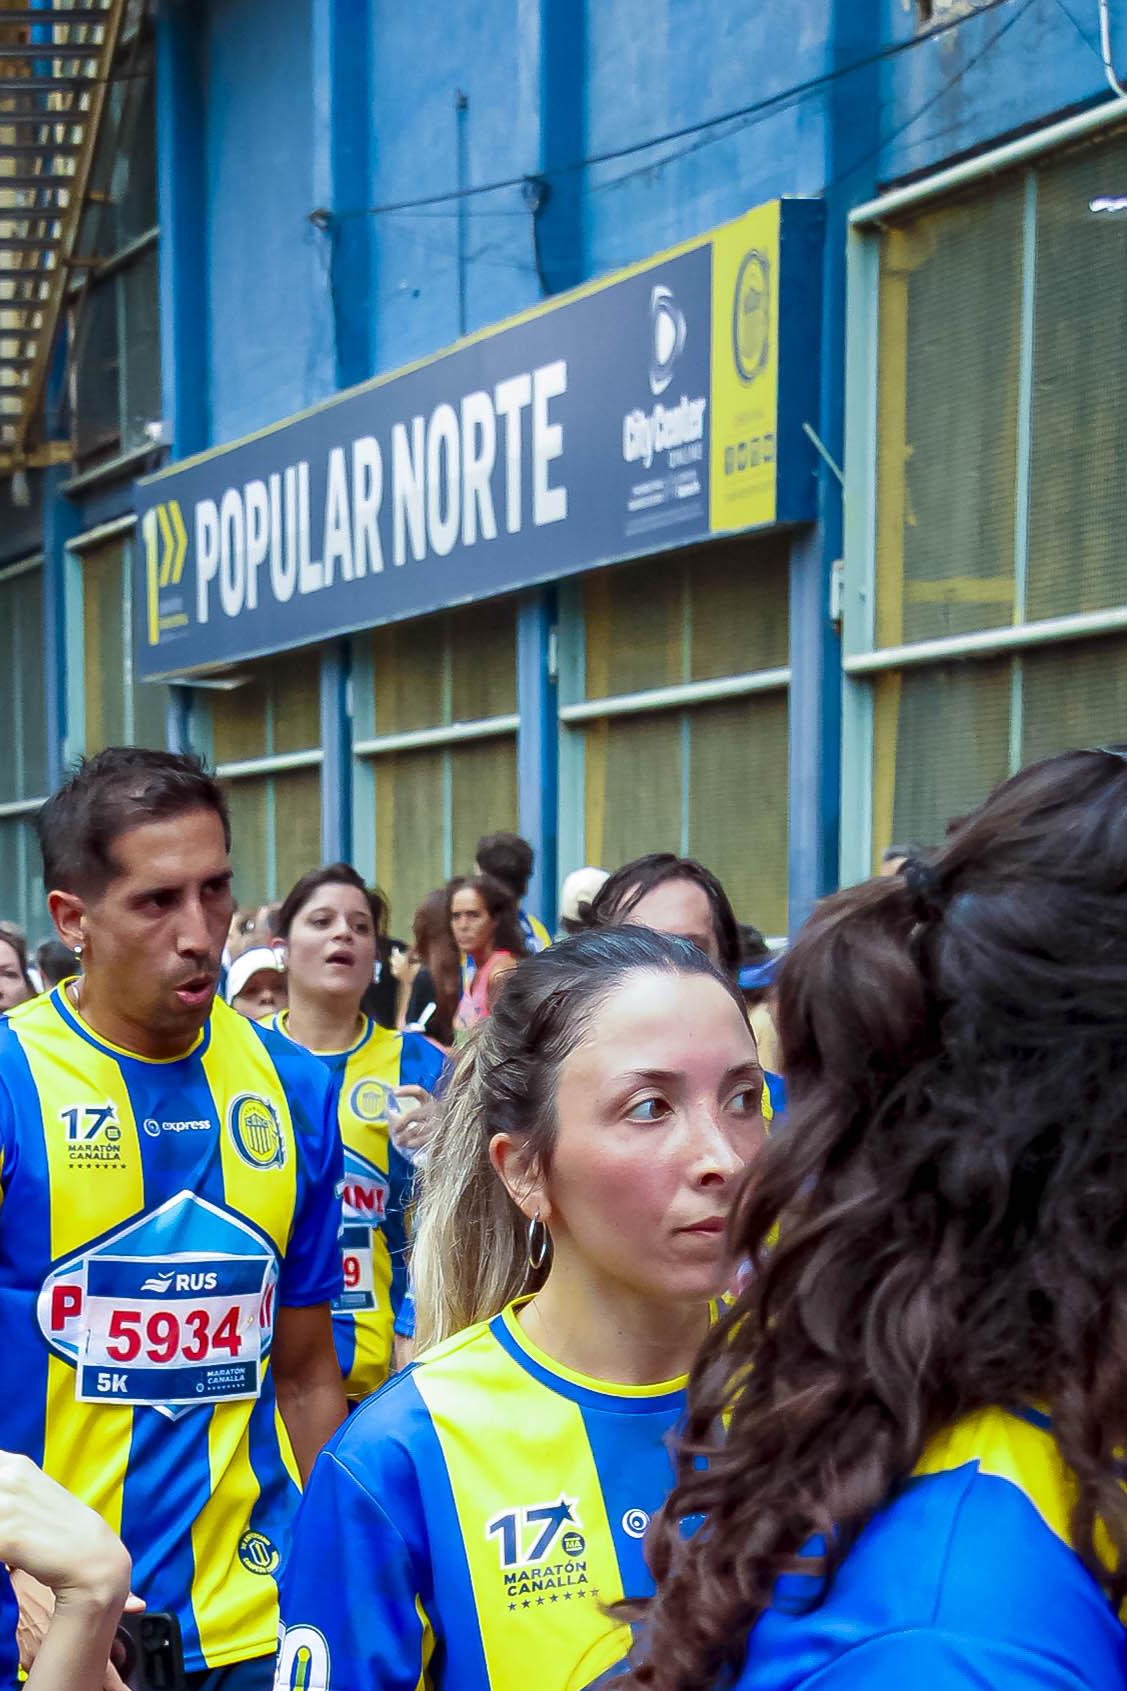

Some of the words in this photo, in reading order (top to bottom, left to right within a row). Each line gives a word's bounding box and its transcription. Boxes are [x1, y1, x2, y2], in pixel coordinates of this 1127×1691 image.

[194, 436, 384, 624] POPULAR
[391, 359, 569, 566] NORTE
[61, 1104, 118, 1141] 17
[161, 1119, 212, 1133] express
[68, 1152, 121, 1161] CANALLA
[175, 1272, 218, 1292] RUS
[106, 1306, 242, 1363] 5934
[96, 1372, 128, 1393] 5K
[485, 1497, 577, 1568] 17
[503, 1560, 588, 1587] MARATÓN
[507, 1573, 589, 1597] CANALLA
